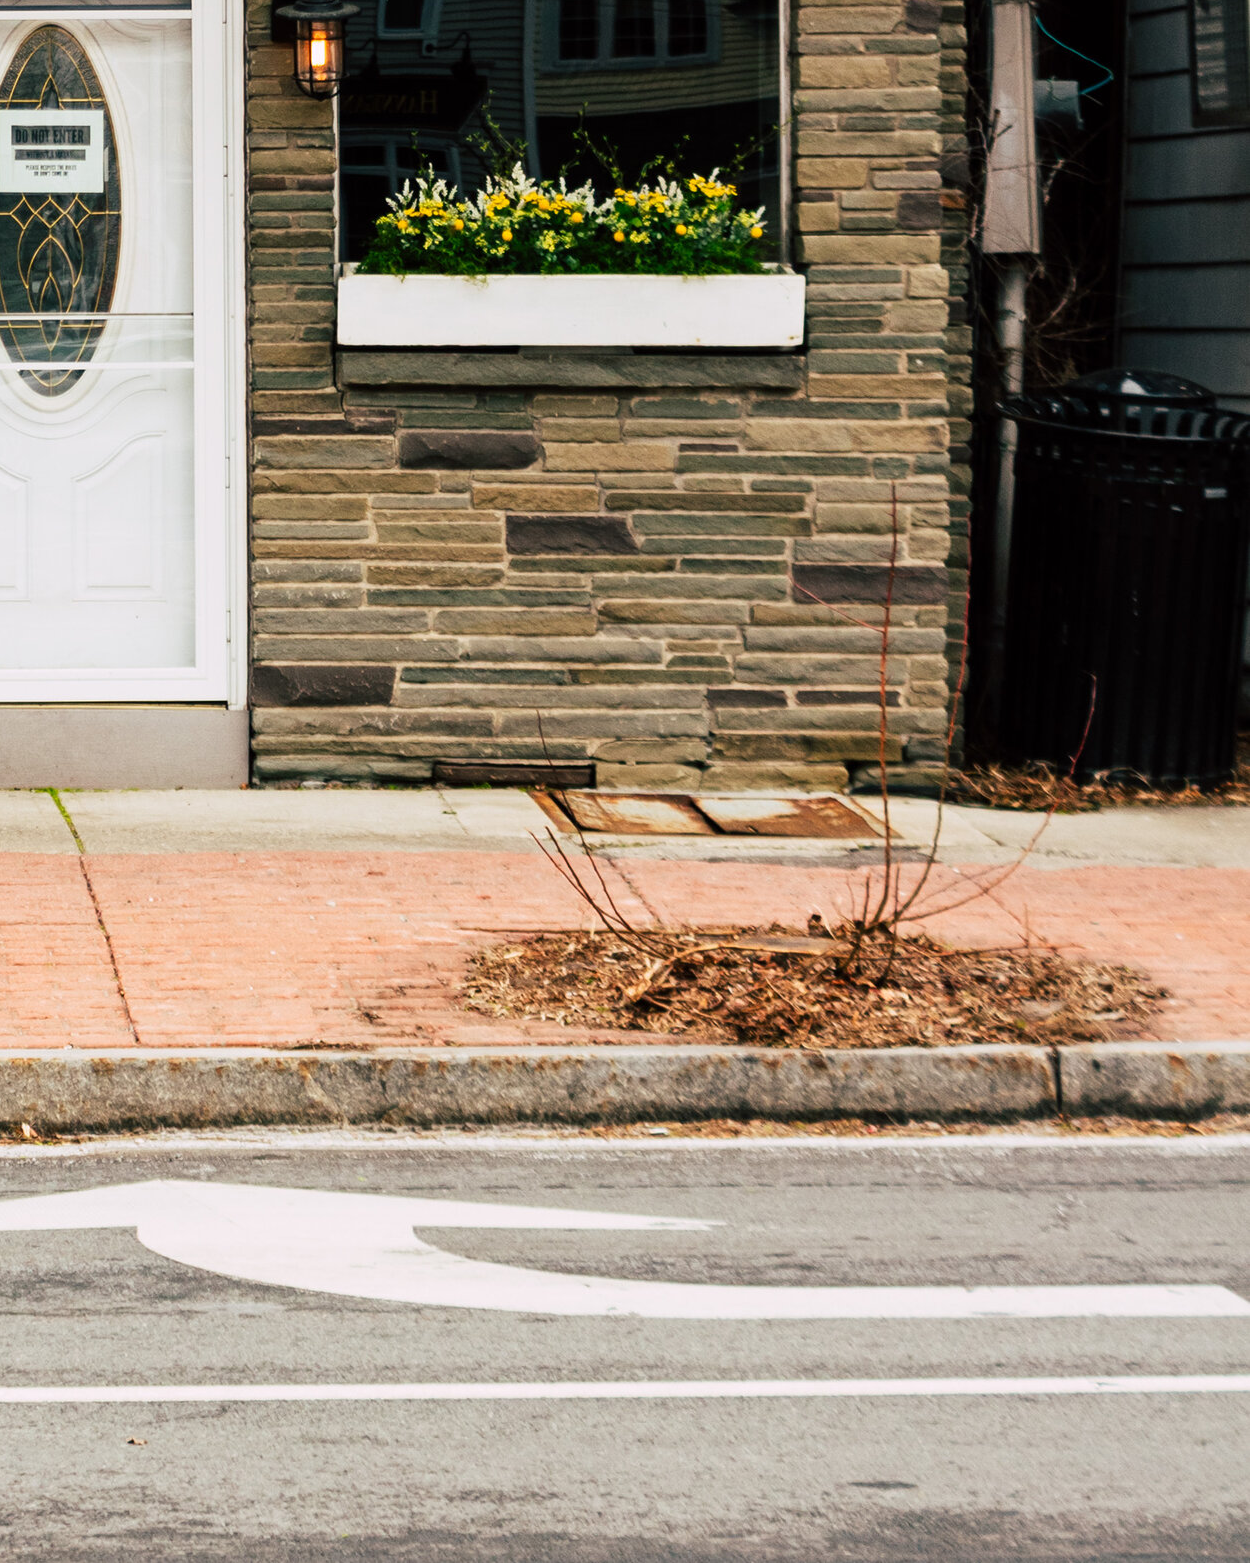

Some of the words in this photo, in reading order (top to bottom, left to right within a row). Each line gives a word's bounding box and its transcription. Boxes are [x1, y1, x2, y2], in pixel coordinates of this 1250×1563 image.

[15, 129, 28, 143] DO
[31, 129, 50, 143] NOT
[53, 129, 84, 144] ENTER
